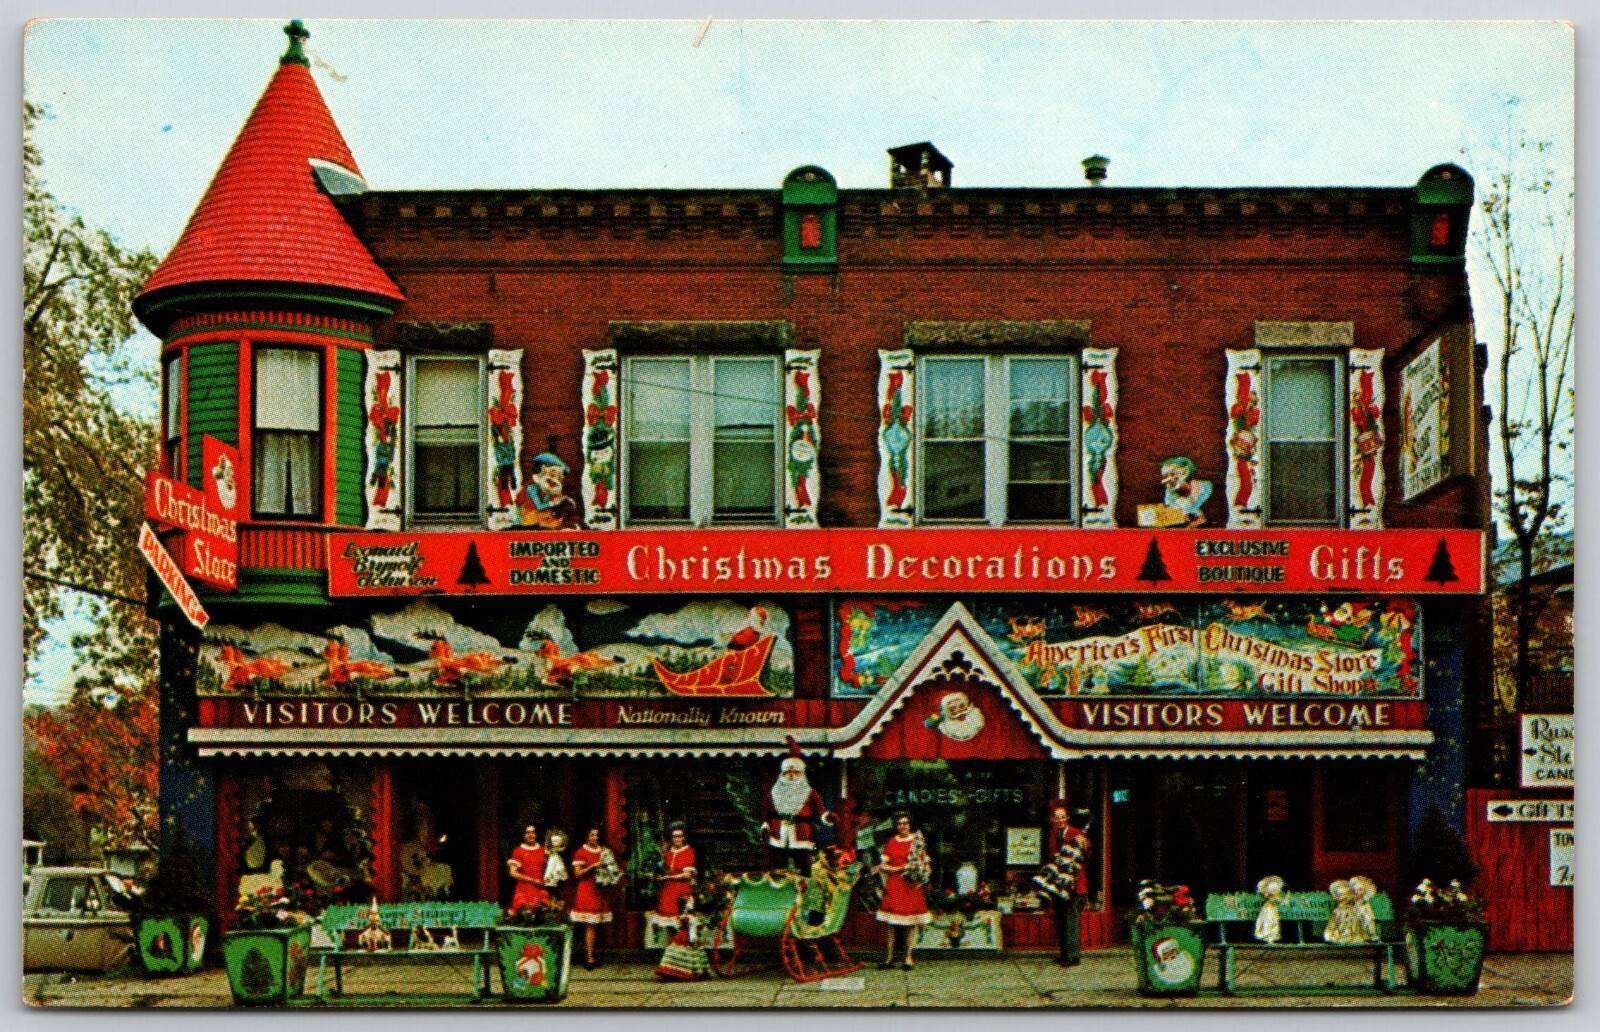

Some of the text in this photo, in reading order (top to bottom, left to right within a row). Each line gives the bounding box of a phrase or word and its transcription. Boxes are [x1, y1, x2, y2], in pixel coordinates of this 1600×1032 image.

[154, 478, 238, 542] Christmas
[509, 541, 601, 557] IMPORTED
[1195, 538, 1290, 557] EXCLUSIVE
[192, 538, 237, 586] Store
[540, 557, 571, 569] AND
[627, 543, 1118, 581] Christmas Decorations
[1309, 544, 1405, 582] Gifts
[509, 568, 601, 585] DOMESTIC
[1197, 565, 1286, 583] BOUTIQUE
[1023, 623, 1379, 675] America's First Christmas Store
[1258, 672, 1362, 696] Gift Shop
[243, 702, 573, 725] VISITORS WELCOME
[616, 705, 786, 727] Nationally Known
[1083, 703, 1391, 727] VISITORS WELCOME
